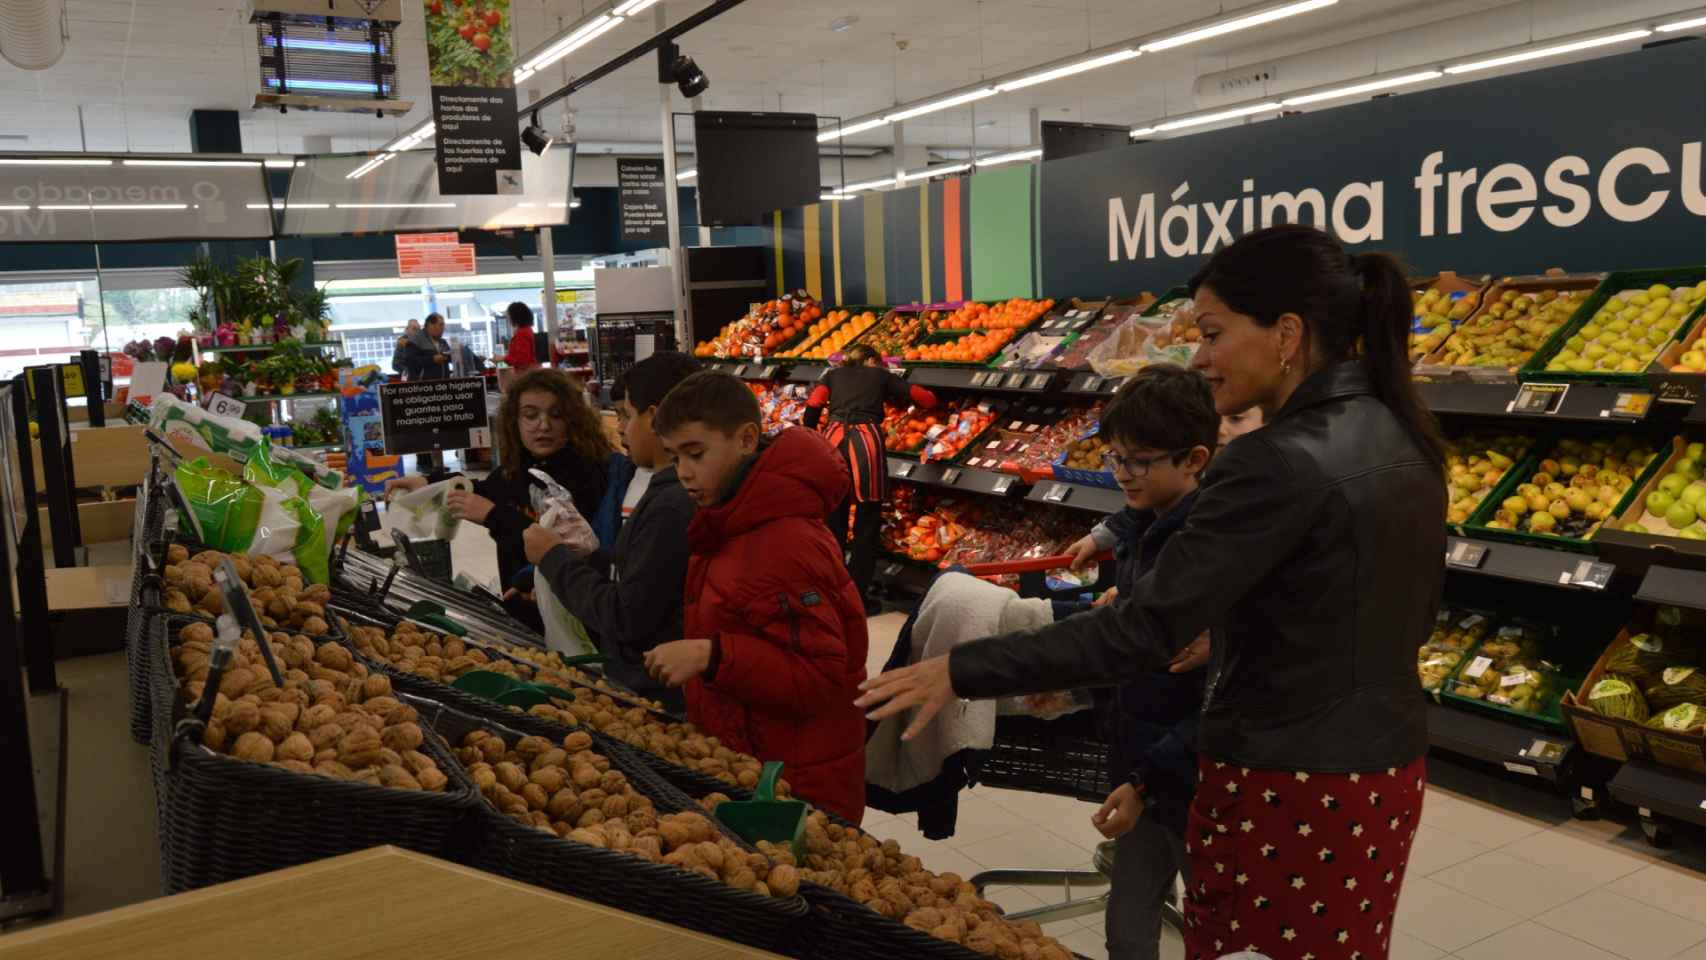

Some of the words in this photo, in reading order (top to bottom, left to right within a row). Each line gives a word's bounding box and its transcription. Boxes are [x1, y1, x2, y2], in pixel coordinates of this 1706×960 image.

[1108, 178, 1384, 262] Máxima
[450, 382, 482, 391] higiene
[404, 406, 440, 416] guantes
